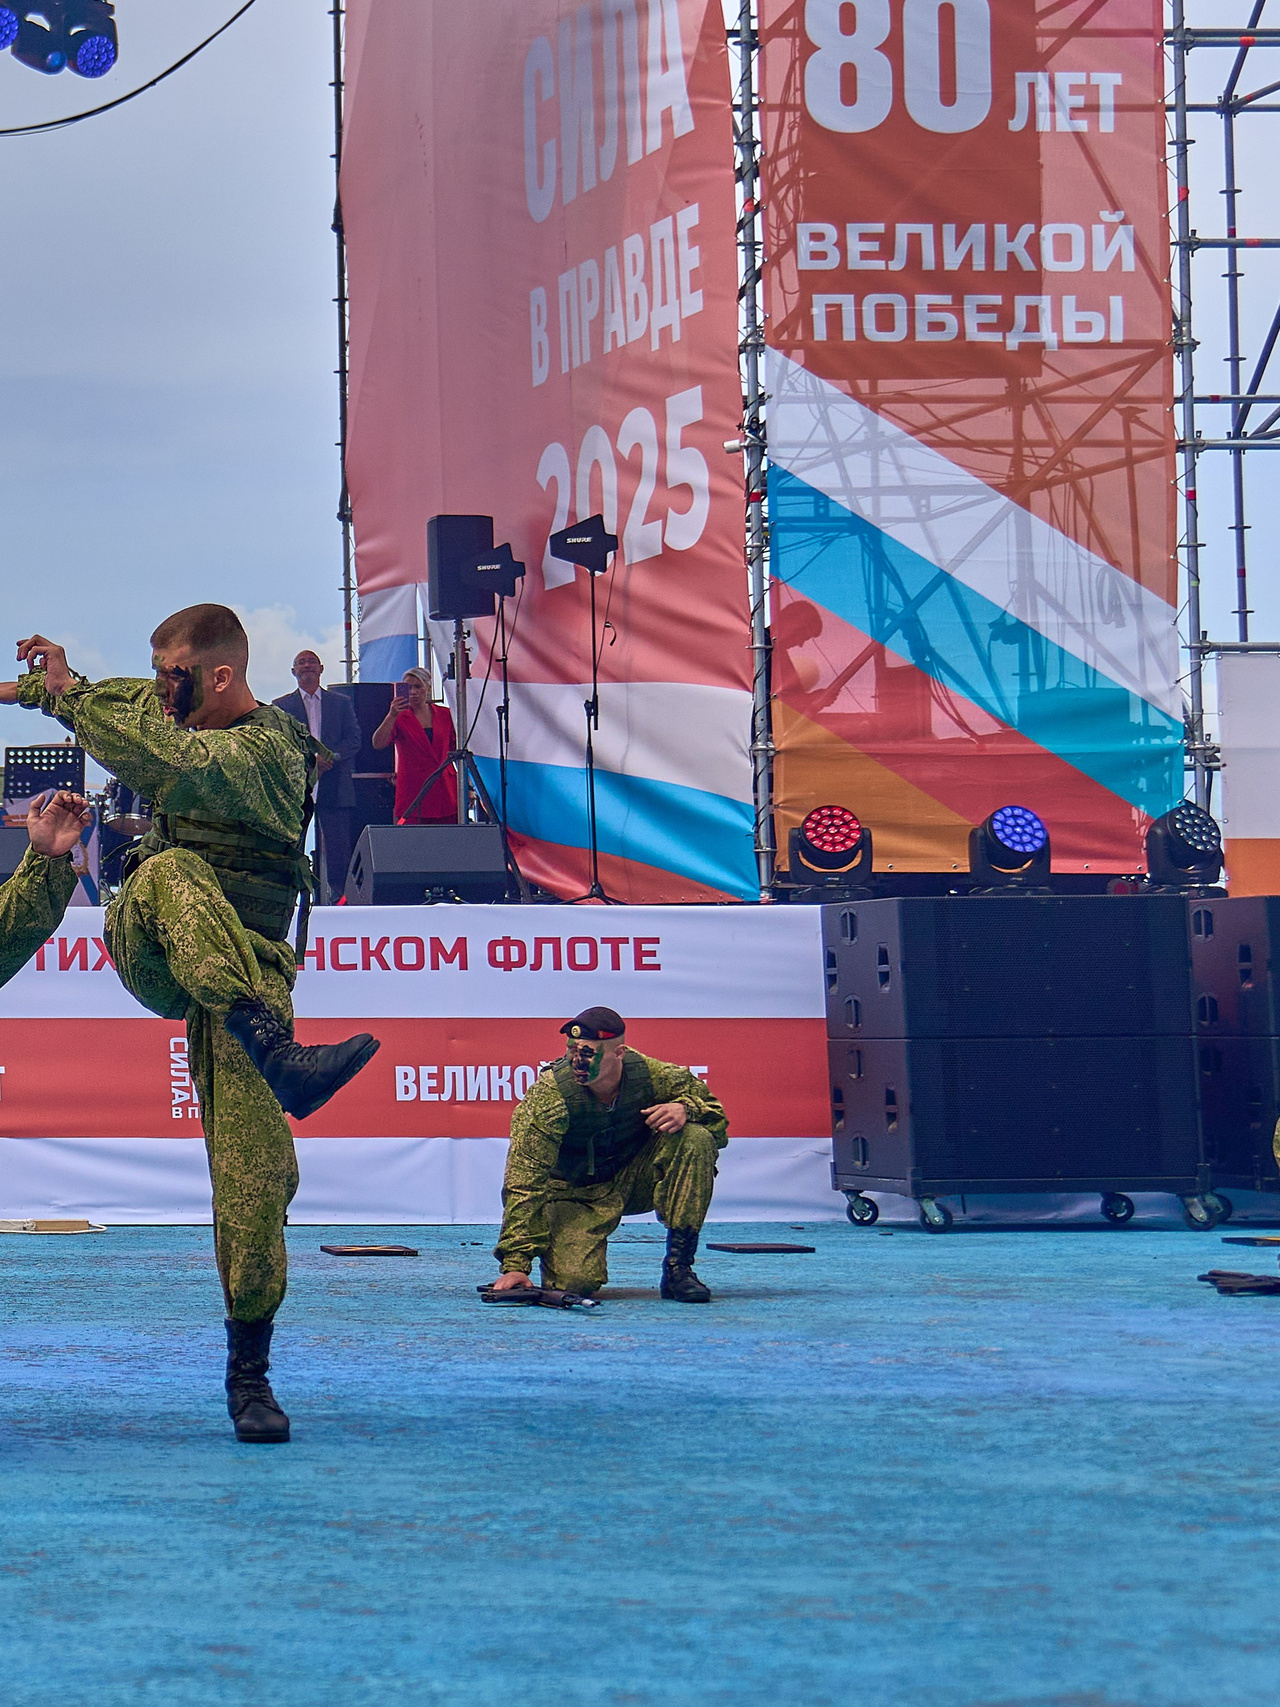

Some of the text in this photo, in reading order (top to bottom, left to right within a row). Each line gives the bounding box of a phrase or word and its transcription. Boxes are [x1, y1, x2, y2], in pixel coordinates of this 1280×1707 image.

[804, 0, 1122, 133] 80 ЛЕТ
[524, 0, 695, 223] СИЛА
[796, 210, 1135, 272] ВЕЛИКОЙ
[530, 202, 703, 388] В ПРАВДЕ
[811, 293, 1124, 351] ПОБЕДЫ
[536, 384, 710, 591] 2025
[477, 563, 501, 571] SHURE
[566, 536, 593, 544] SHURE
[487, 936, 662, 972] ФЛОТЕ
[169, 1037, 190, 1106] СИЛА
[395, 1061, 553, 1102] ВЕЛИКО
[171, 1106, 183, 1119] В
